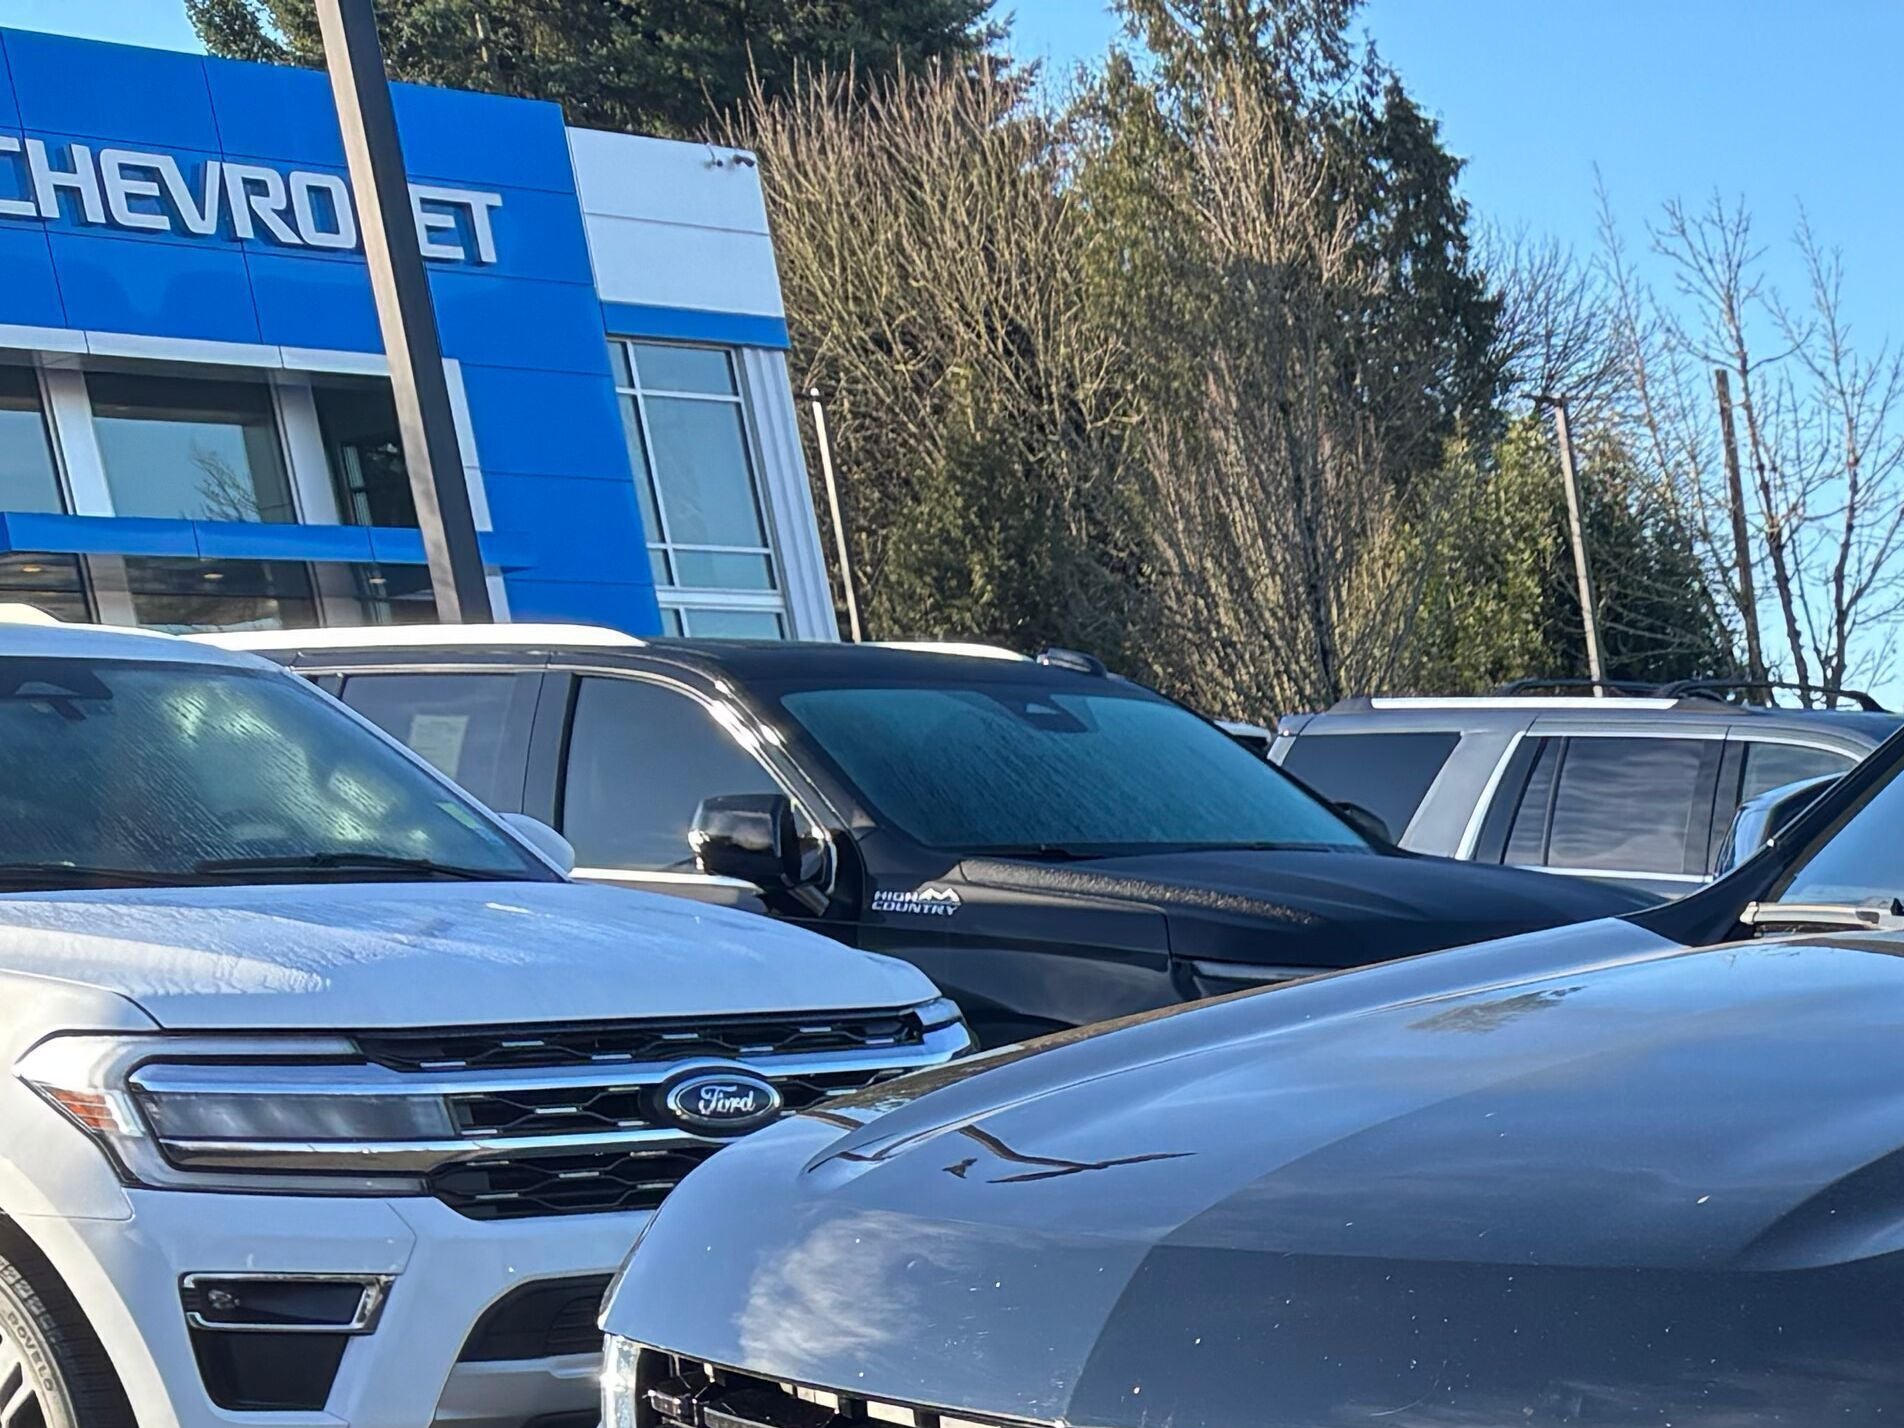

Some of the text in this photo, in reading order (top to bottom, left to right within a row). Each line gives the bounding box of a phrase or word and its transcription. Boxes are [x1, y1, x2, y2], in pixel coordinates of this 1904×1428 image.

[874, 890, 918, 902] HIGH
[872, 901, 958, 916] COUNTRY
[698, 1084, 756, 1116] Ford
